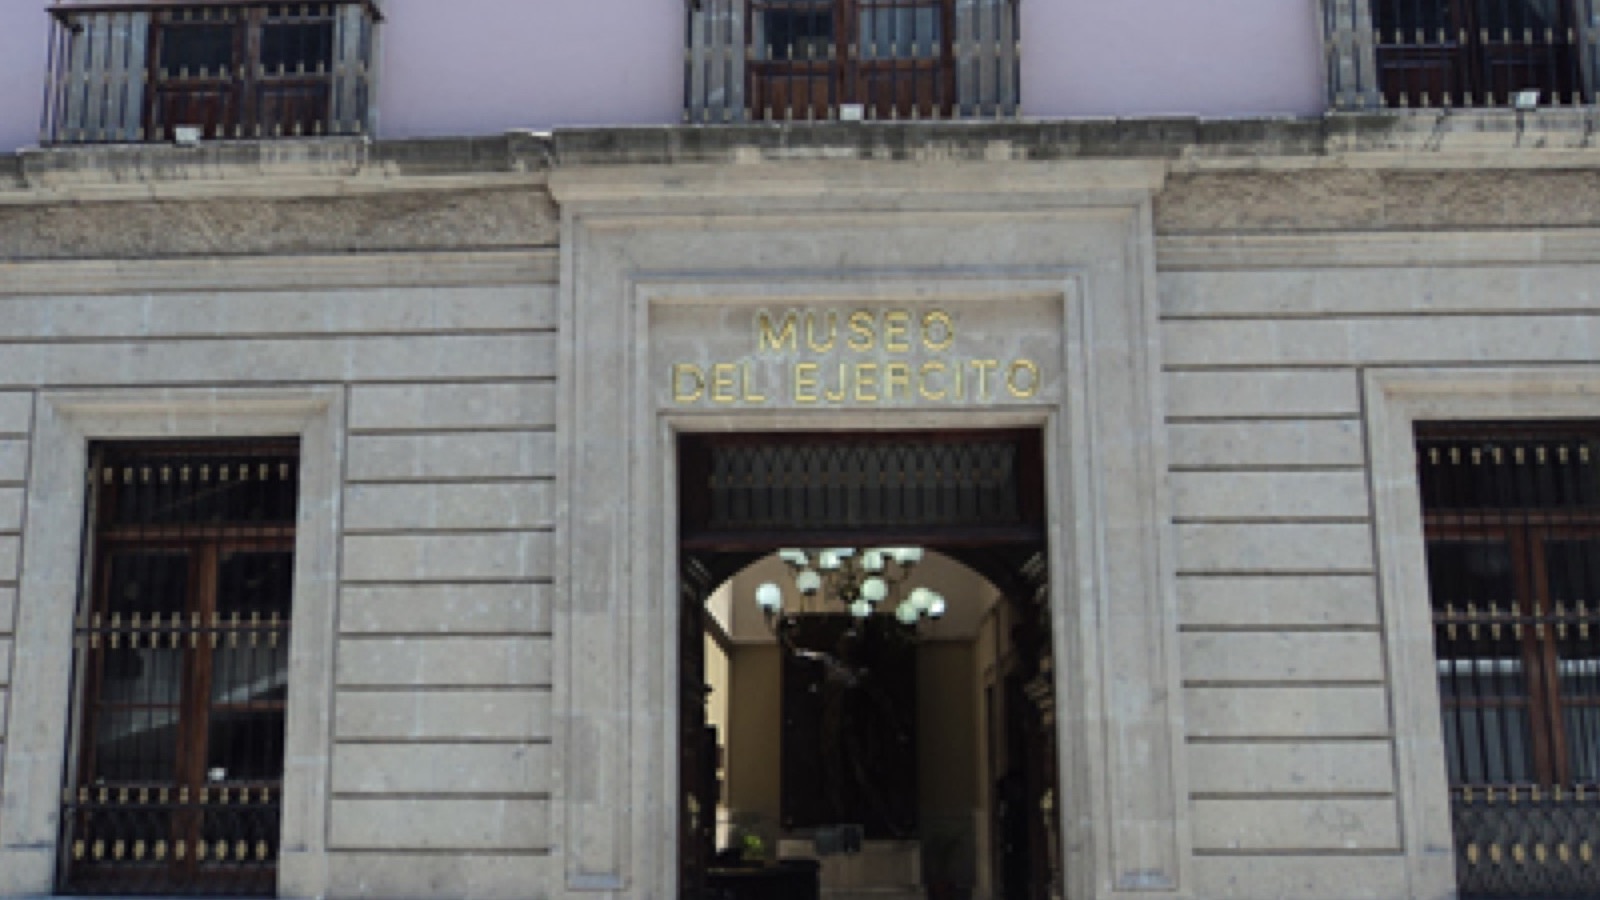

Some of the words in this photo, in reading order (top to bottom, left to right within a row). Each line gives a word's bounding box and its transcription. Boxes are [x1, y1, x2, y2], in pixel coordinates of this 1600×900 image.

[758, 309, 954, 352] MUSEO
[672, 362, 765, 402] DEL
[794, 359, 1041, 402] EJERCITO
